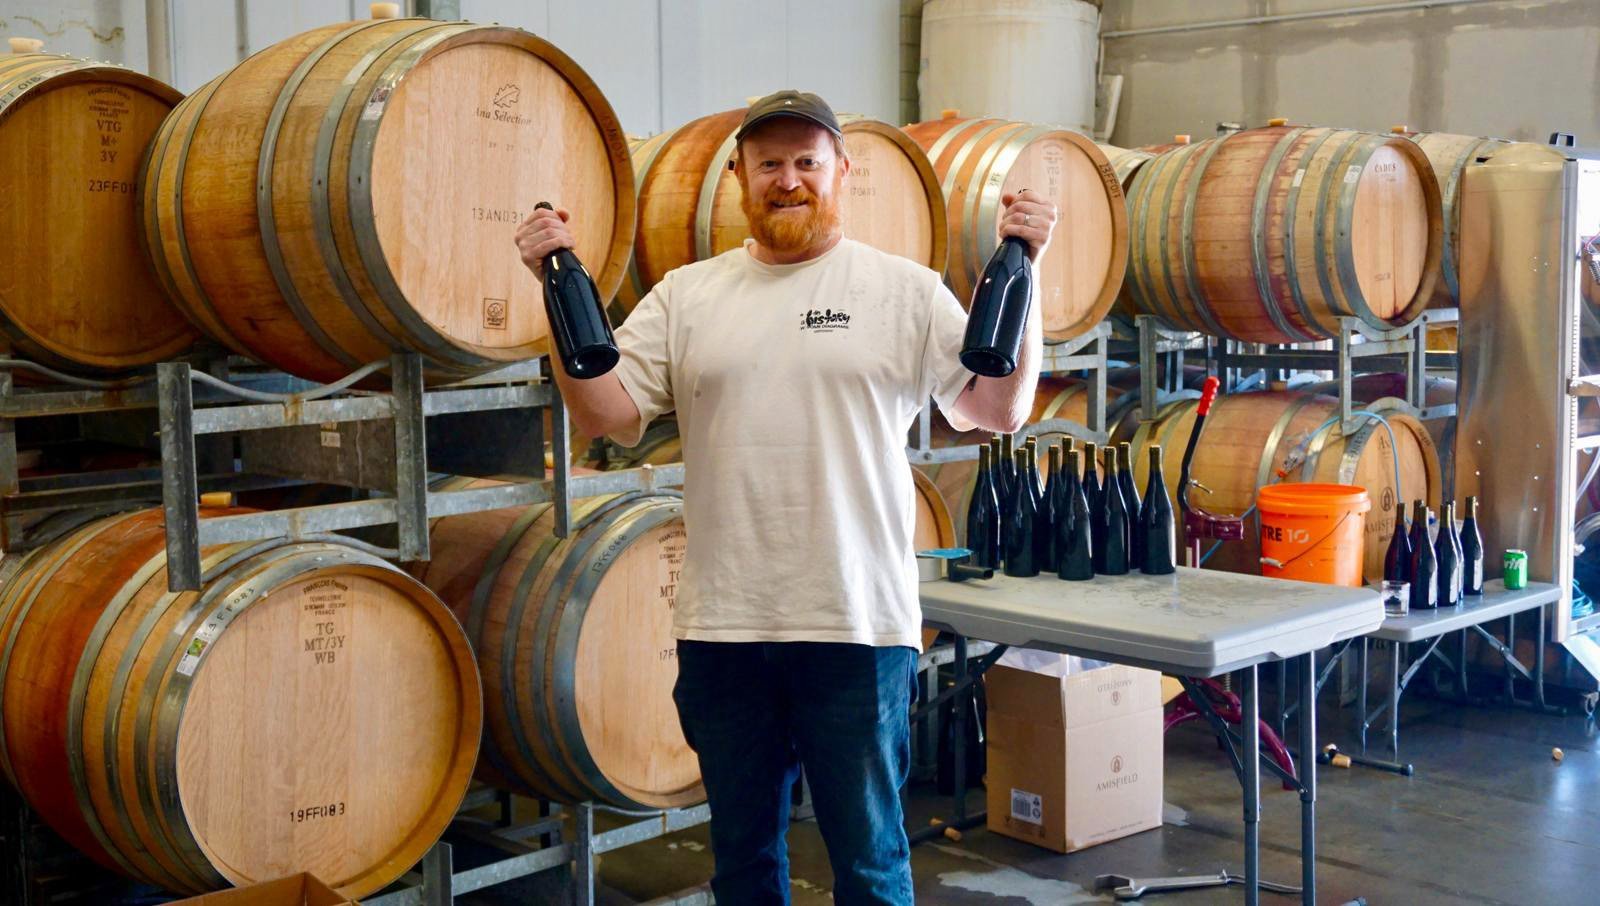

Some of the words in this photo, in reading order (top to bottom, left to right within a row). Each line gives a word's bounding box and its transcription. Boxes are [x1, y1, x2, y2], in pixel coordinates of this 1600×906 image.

[97, 120, 121, 132] VTG
[101, 151, 117, 163] 3Y
[1286, 528, 1310, 543] 10
[316, 622, 334, 635] TG
[304, 636, 345, 651] MT/3Y
[315, 651, 335, 664] WB
[1096, 772, 1138, 792] AMISFIELD
